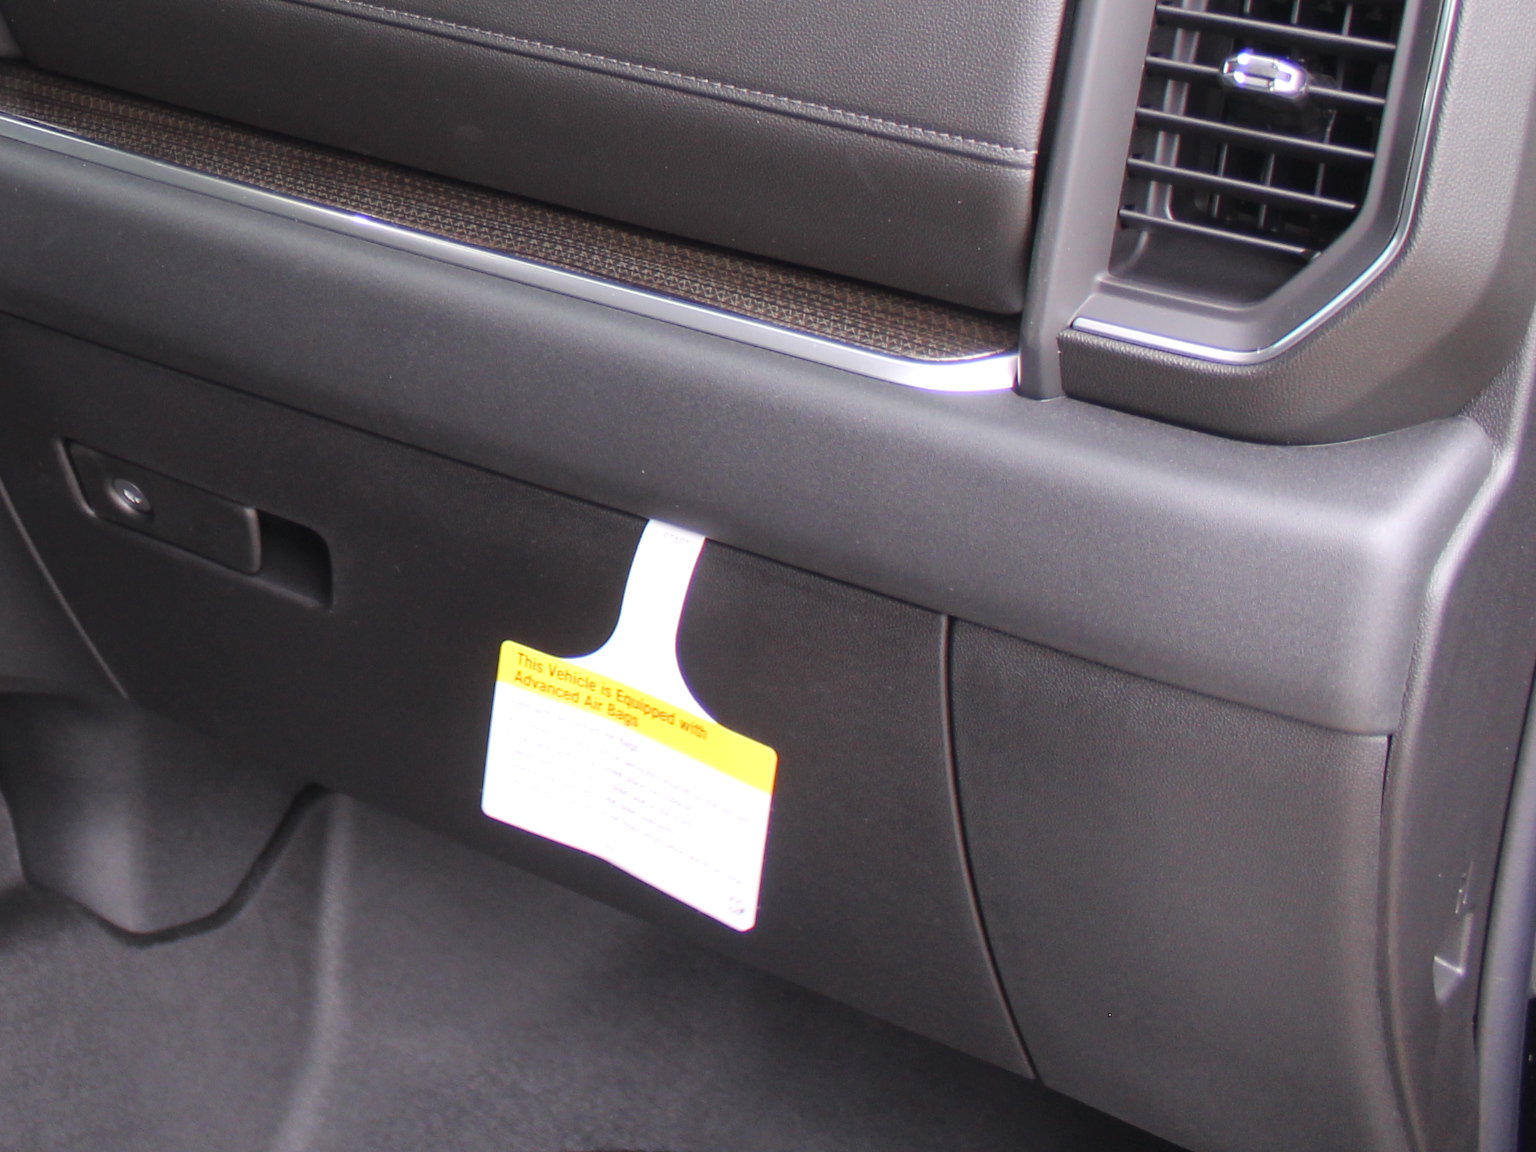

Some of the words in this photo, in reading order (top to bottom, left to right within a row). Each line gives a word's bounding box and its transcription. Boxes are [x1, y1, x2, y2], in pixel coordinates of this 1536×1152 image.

[514, 670, 580, 704] Advanced
[584, 695, 604, 712] Air
[607, 703, 639, 727] Bags
[517, 652, 544, 674] This
[548, 664, 597, 692] Vehicle
[601, 685, 613, 698] is
[616, 689, 676, 726] Equipped
[679, 719, 708, 740] with
